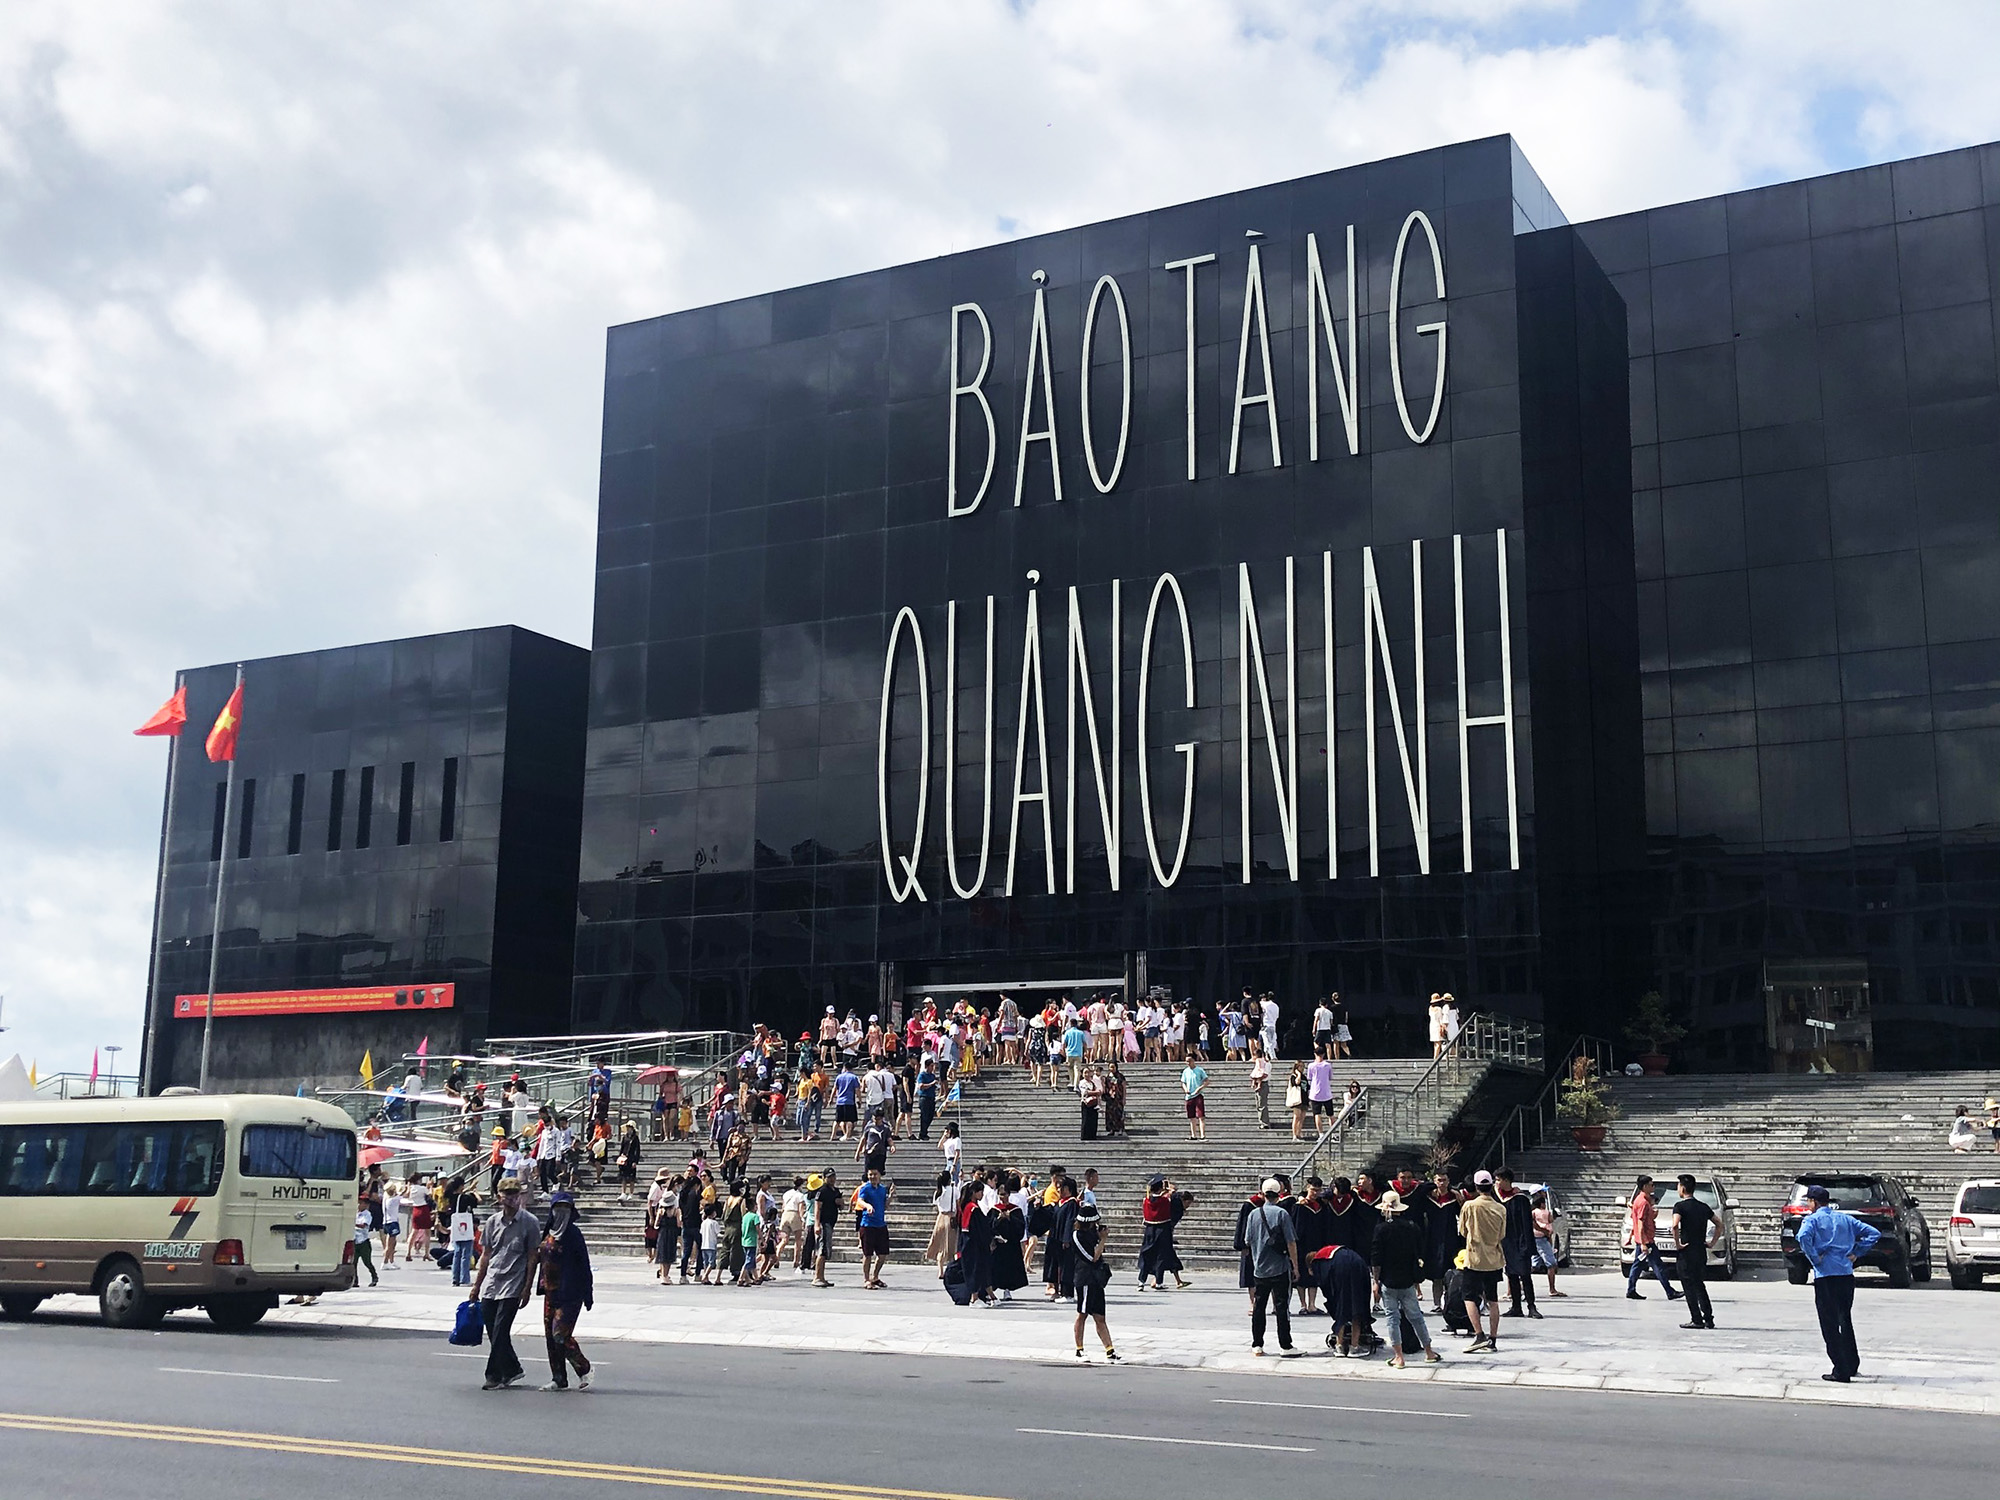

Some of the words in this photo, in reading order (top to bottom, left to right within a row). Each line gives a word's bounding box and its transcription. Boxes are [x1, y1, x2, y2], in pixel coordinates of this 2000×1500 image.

[947, 269, 1131, 518] BẢO
[1164, 209, 1448, 481] TÀNG
[878, 569, 1197, 903] QUẢNG
[1239, 528, 1520, 884] NINH
[272, 1185, 331, 1199] HYUNDAI
